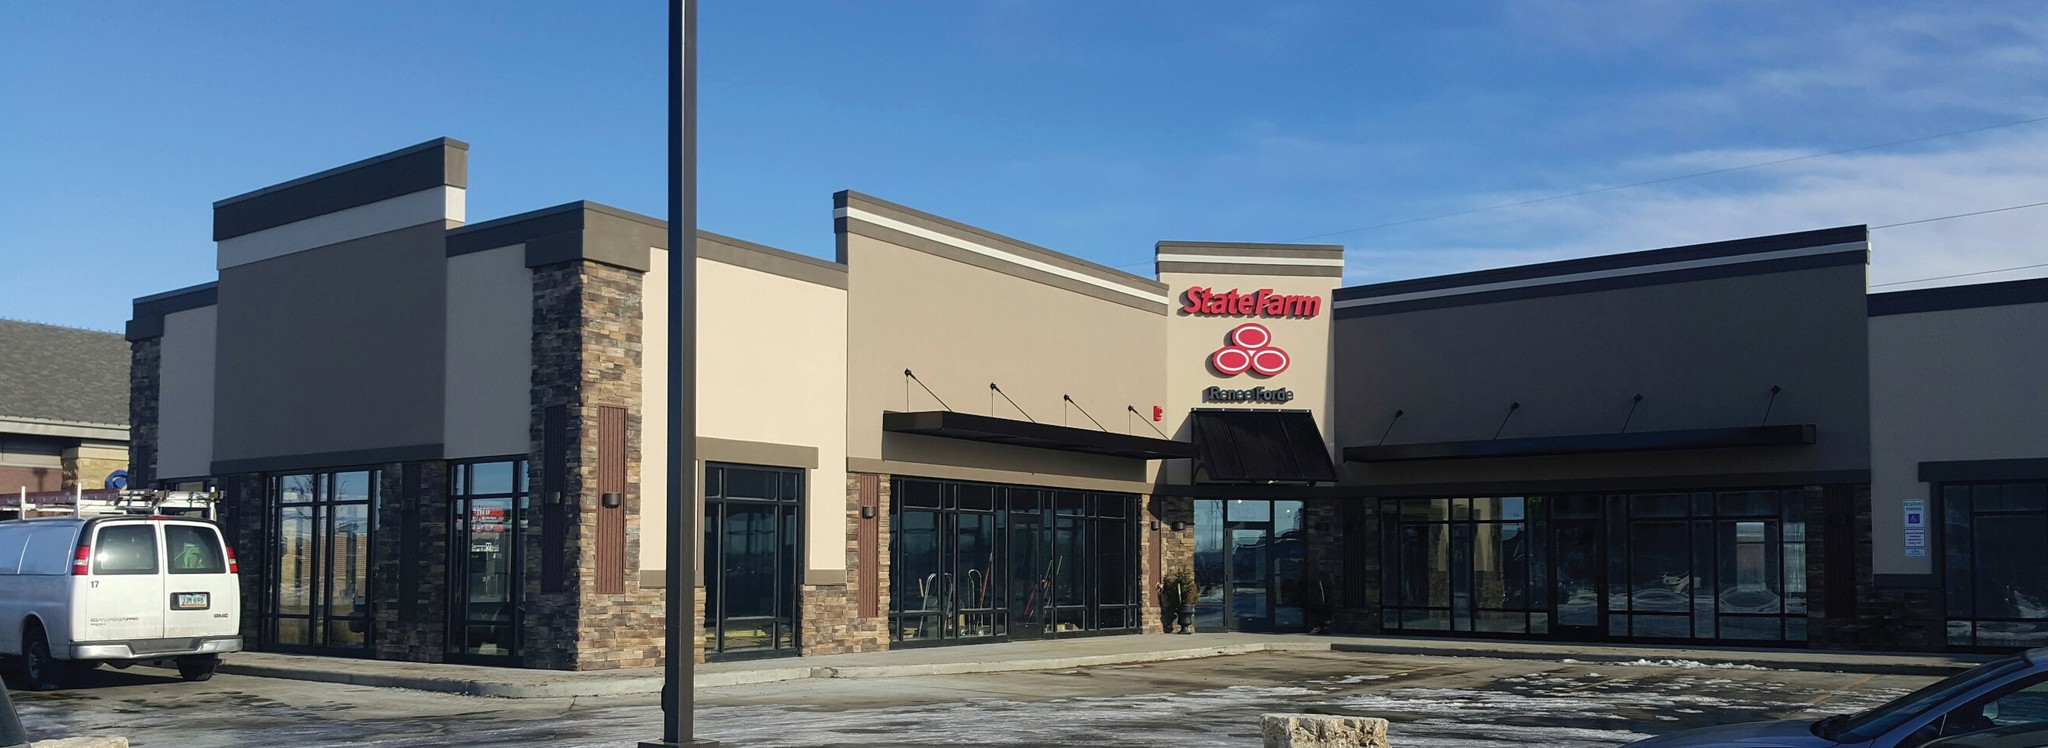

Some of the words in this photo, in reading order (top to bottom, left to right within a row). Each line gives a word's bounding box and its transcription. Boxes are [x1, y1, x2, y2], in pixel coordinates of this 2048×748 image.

[1208, 386, 1252, 401] Renee
[1256, 386, 1293, 402] Forde
[90, 580, 99, 588] 17
